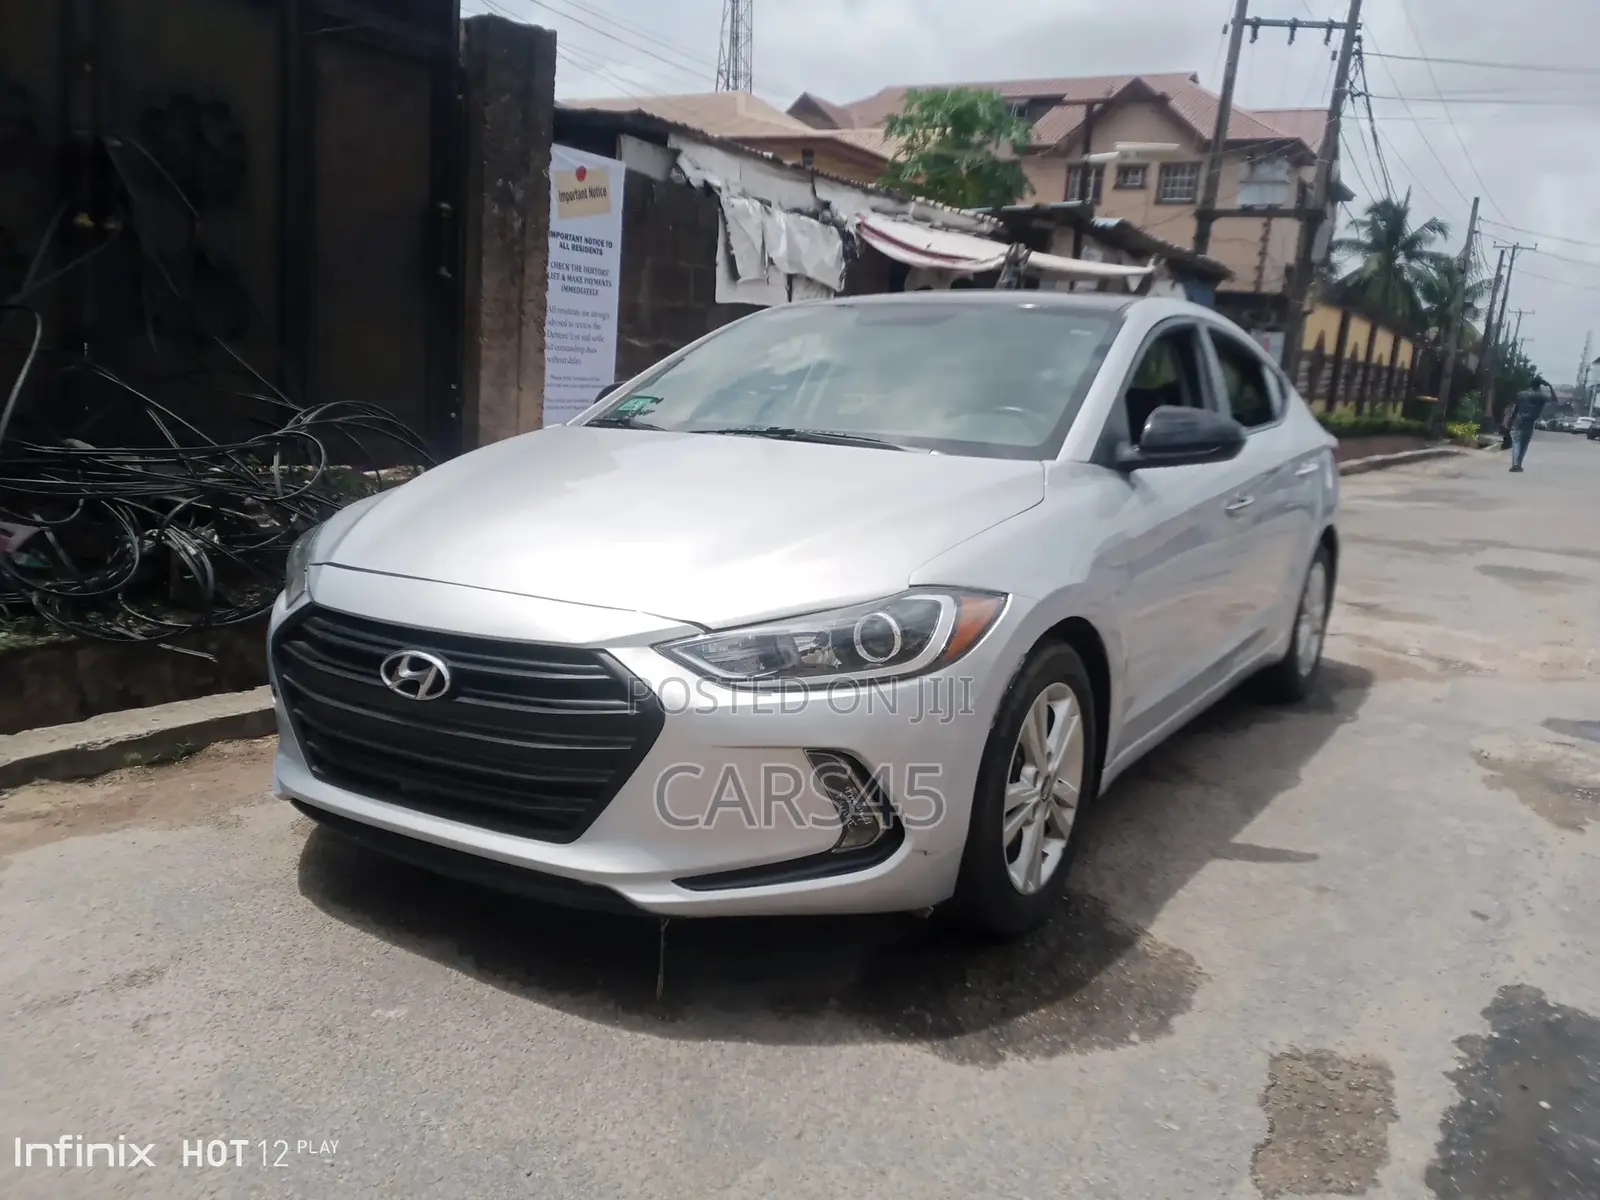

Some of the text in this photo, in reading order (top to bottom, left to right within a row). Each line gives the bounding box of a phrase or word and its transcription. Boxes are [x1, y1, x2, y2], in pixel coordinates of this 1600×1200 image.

[558, 184, 607, 204] Important Notice
[548, 230, 613, 248] IMPORTANT NOTICE TO
[559, 241, 603, 256] ALL RESIDENTS
[550, 261, 570, 270] CHECK
[571, 264, 582, 272] THE
[567, 274, 583, 284] MAKE
[584, 277, 612, 287] PAYMENTS
[561, 284, 599, 296] IMMEDIATELY
